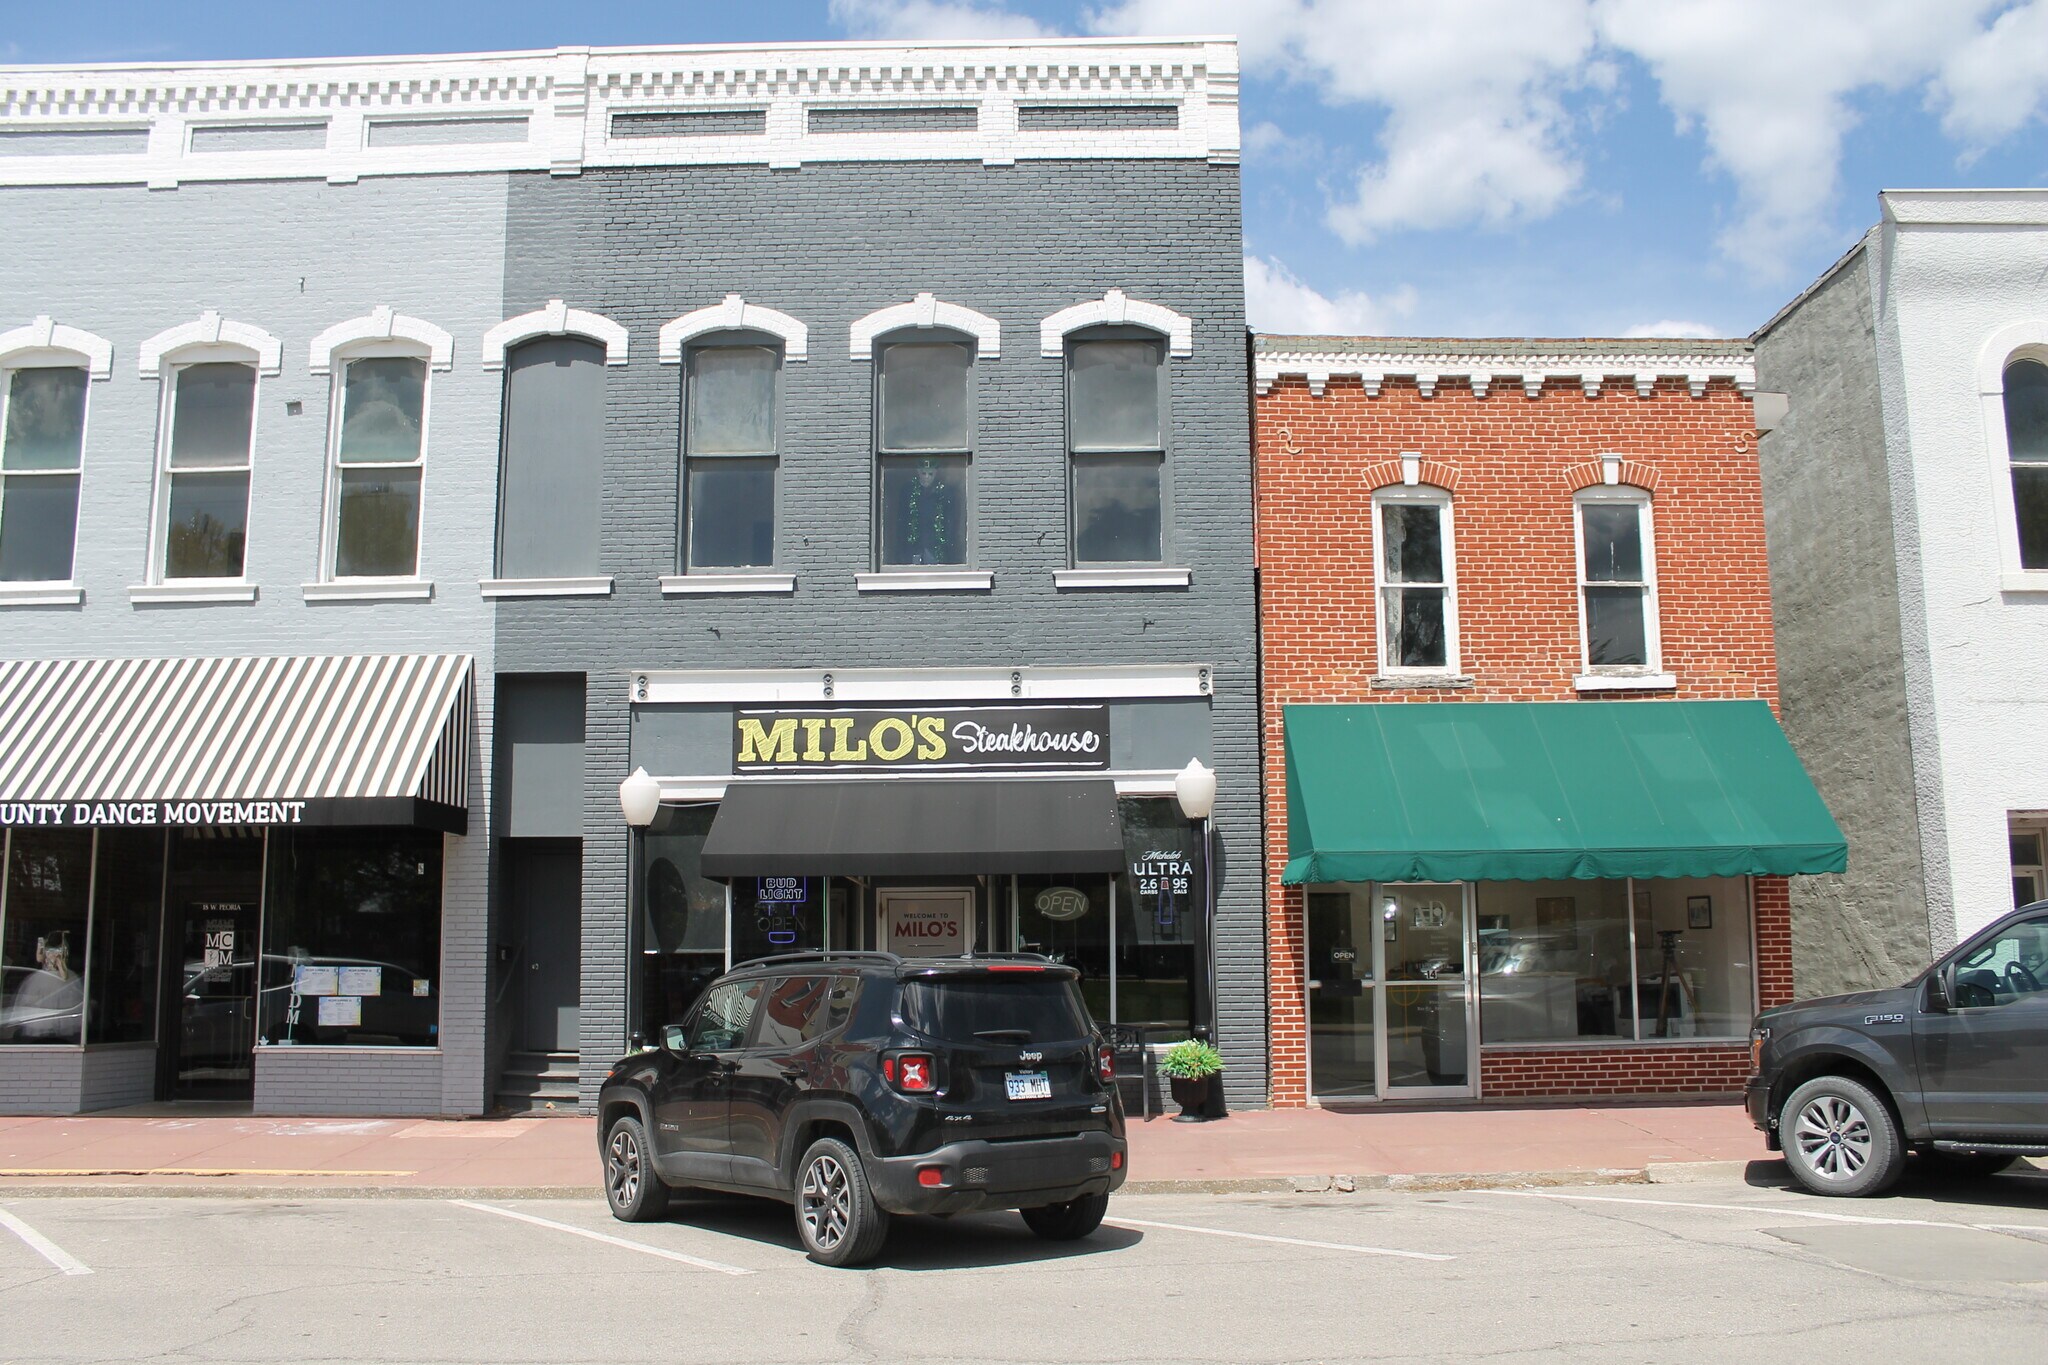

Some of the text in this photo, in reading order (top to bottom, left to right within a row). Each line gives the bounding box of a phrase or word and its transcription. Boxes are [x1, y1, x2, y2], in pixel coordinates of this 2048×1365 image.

[737, 715, 1100, 762] MILO'S Steakhouse
[73, 803, 157, 825] DANCE
[163, 801, 306, 824] MOVEMENT
[1141, 850, 1182, 861] Michelob
[1133, 862, 1193, 876] ULTRA
[765, 877, 797, 889] BUD
[1140, 878, 1188, 890] 2.6 95
[760, 888, 803, 900] LIGHT
[1037, 896, 1086, 913] OPEN
[895, 921, 958, 938] MILO'S
[1333, 951, 1355, 959] OPEN
[1426, 970, 1437, 979] 14
[1019, 1050, 1043, 1062] Jeep
[1008, 1079, 1026, 1094] 933
